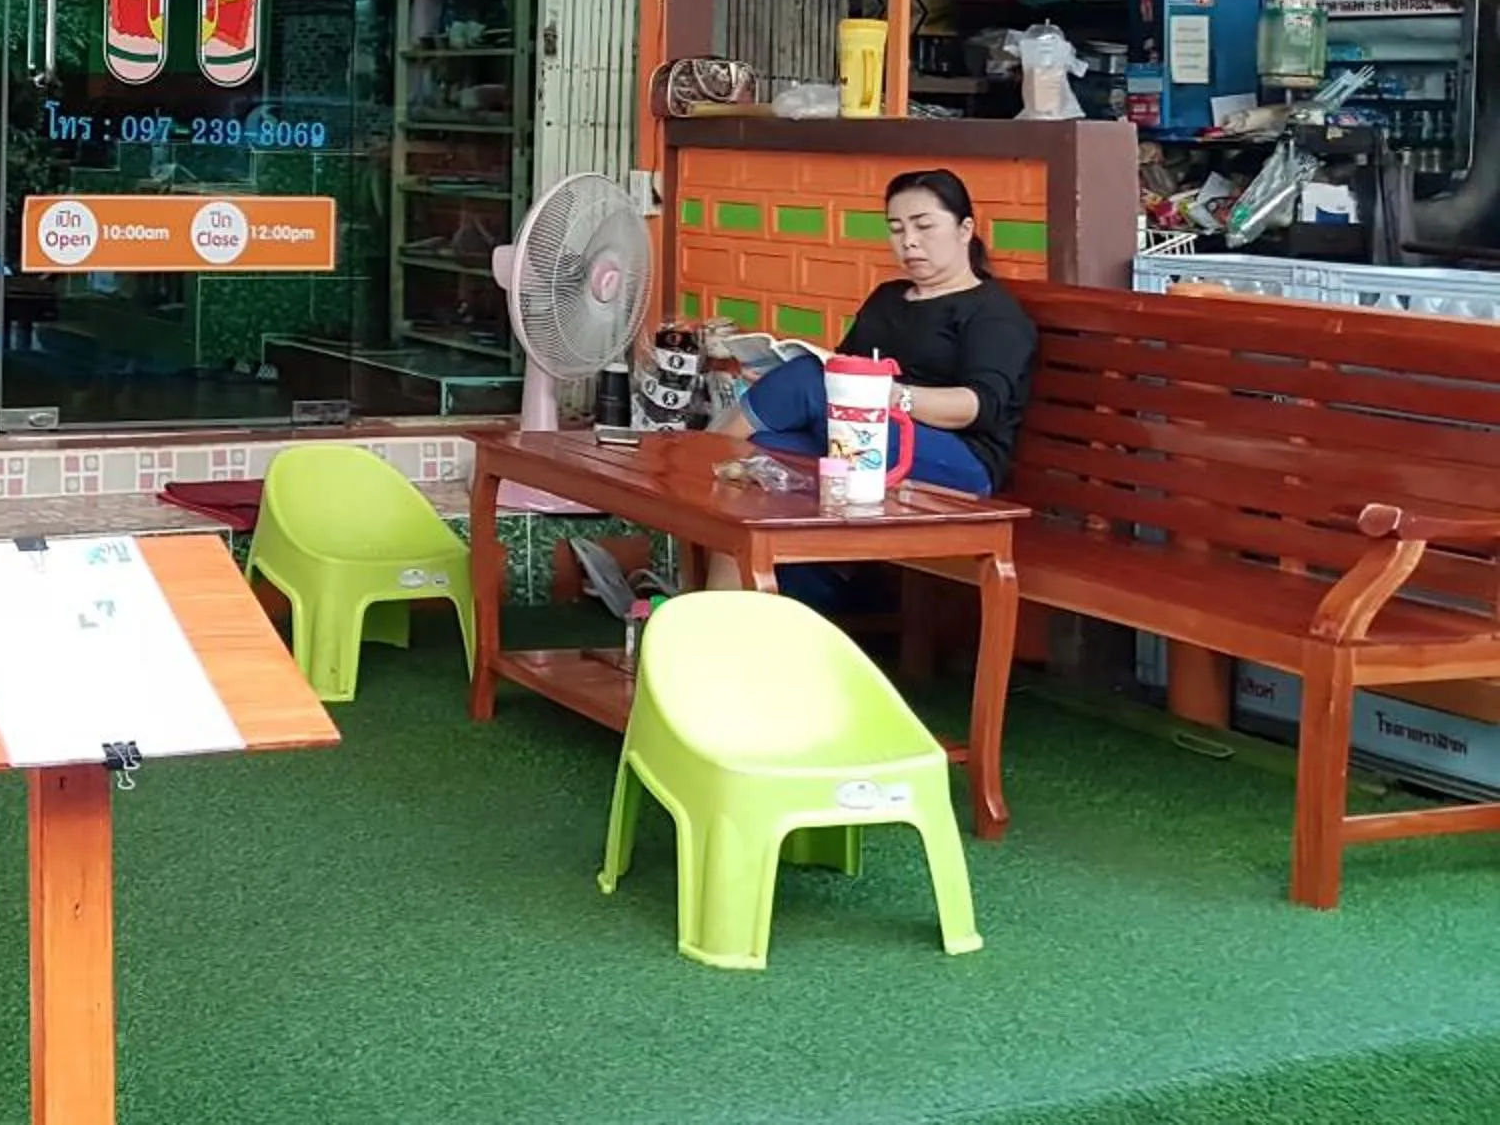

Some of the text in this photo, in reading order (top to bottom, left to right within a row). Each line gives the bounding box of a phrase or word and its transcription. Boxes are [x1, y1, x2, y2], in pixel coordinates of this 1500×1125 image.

[45, 100, 93, 141] โทร
[45, 230, 91, 250] Open
[102, 224, 170, 241] 10:00am
[197, 231, 240, 247] Close
[250, 224, 316, 243] 12:00pm
